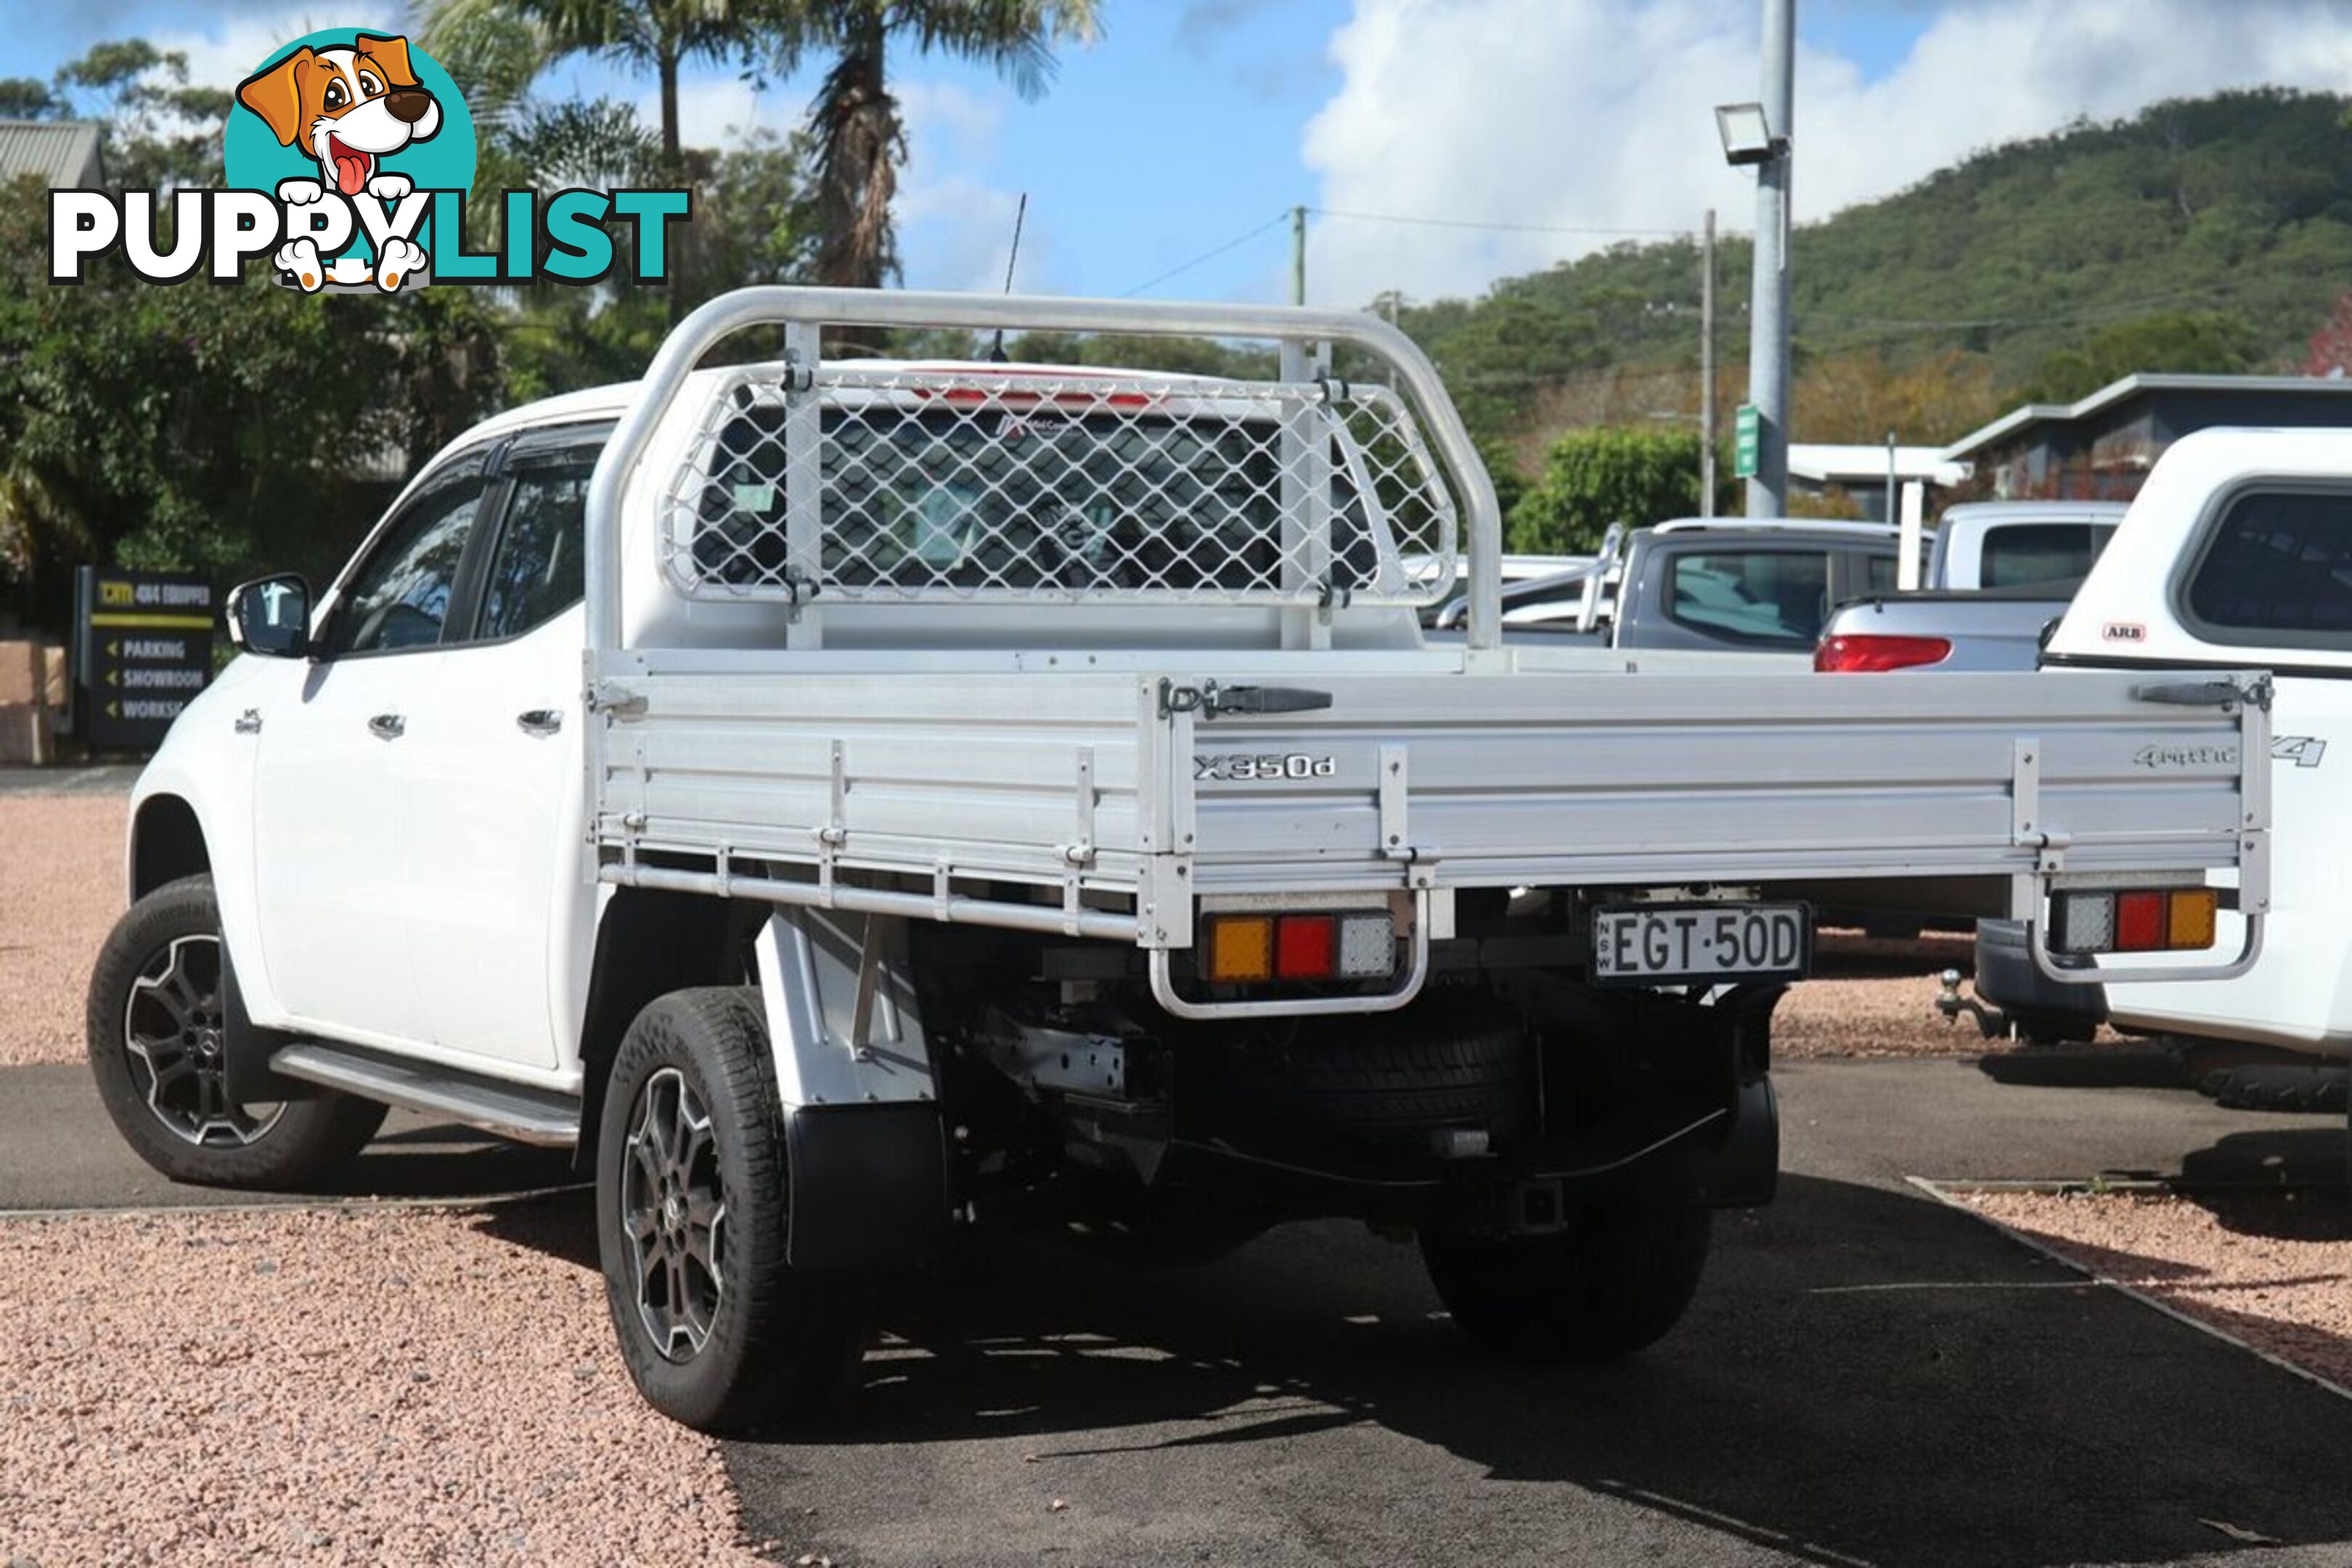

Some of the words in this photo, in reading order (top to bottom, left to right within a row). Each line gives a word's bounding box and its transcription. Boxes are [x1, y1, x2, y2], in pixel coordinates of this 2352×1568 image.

[2107, 626, 2141, 638] ARB
[123, 640, 186, 658] PARKING
[123, 669, 204, 688] SHOWROOM
[1193, 752, 1336, 780] X350d
